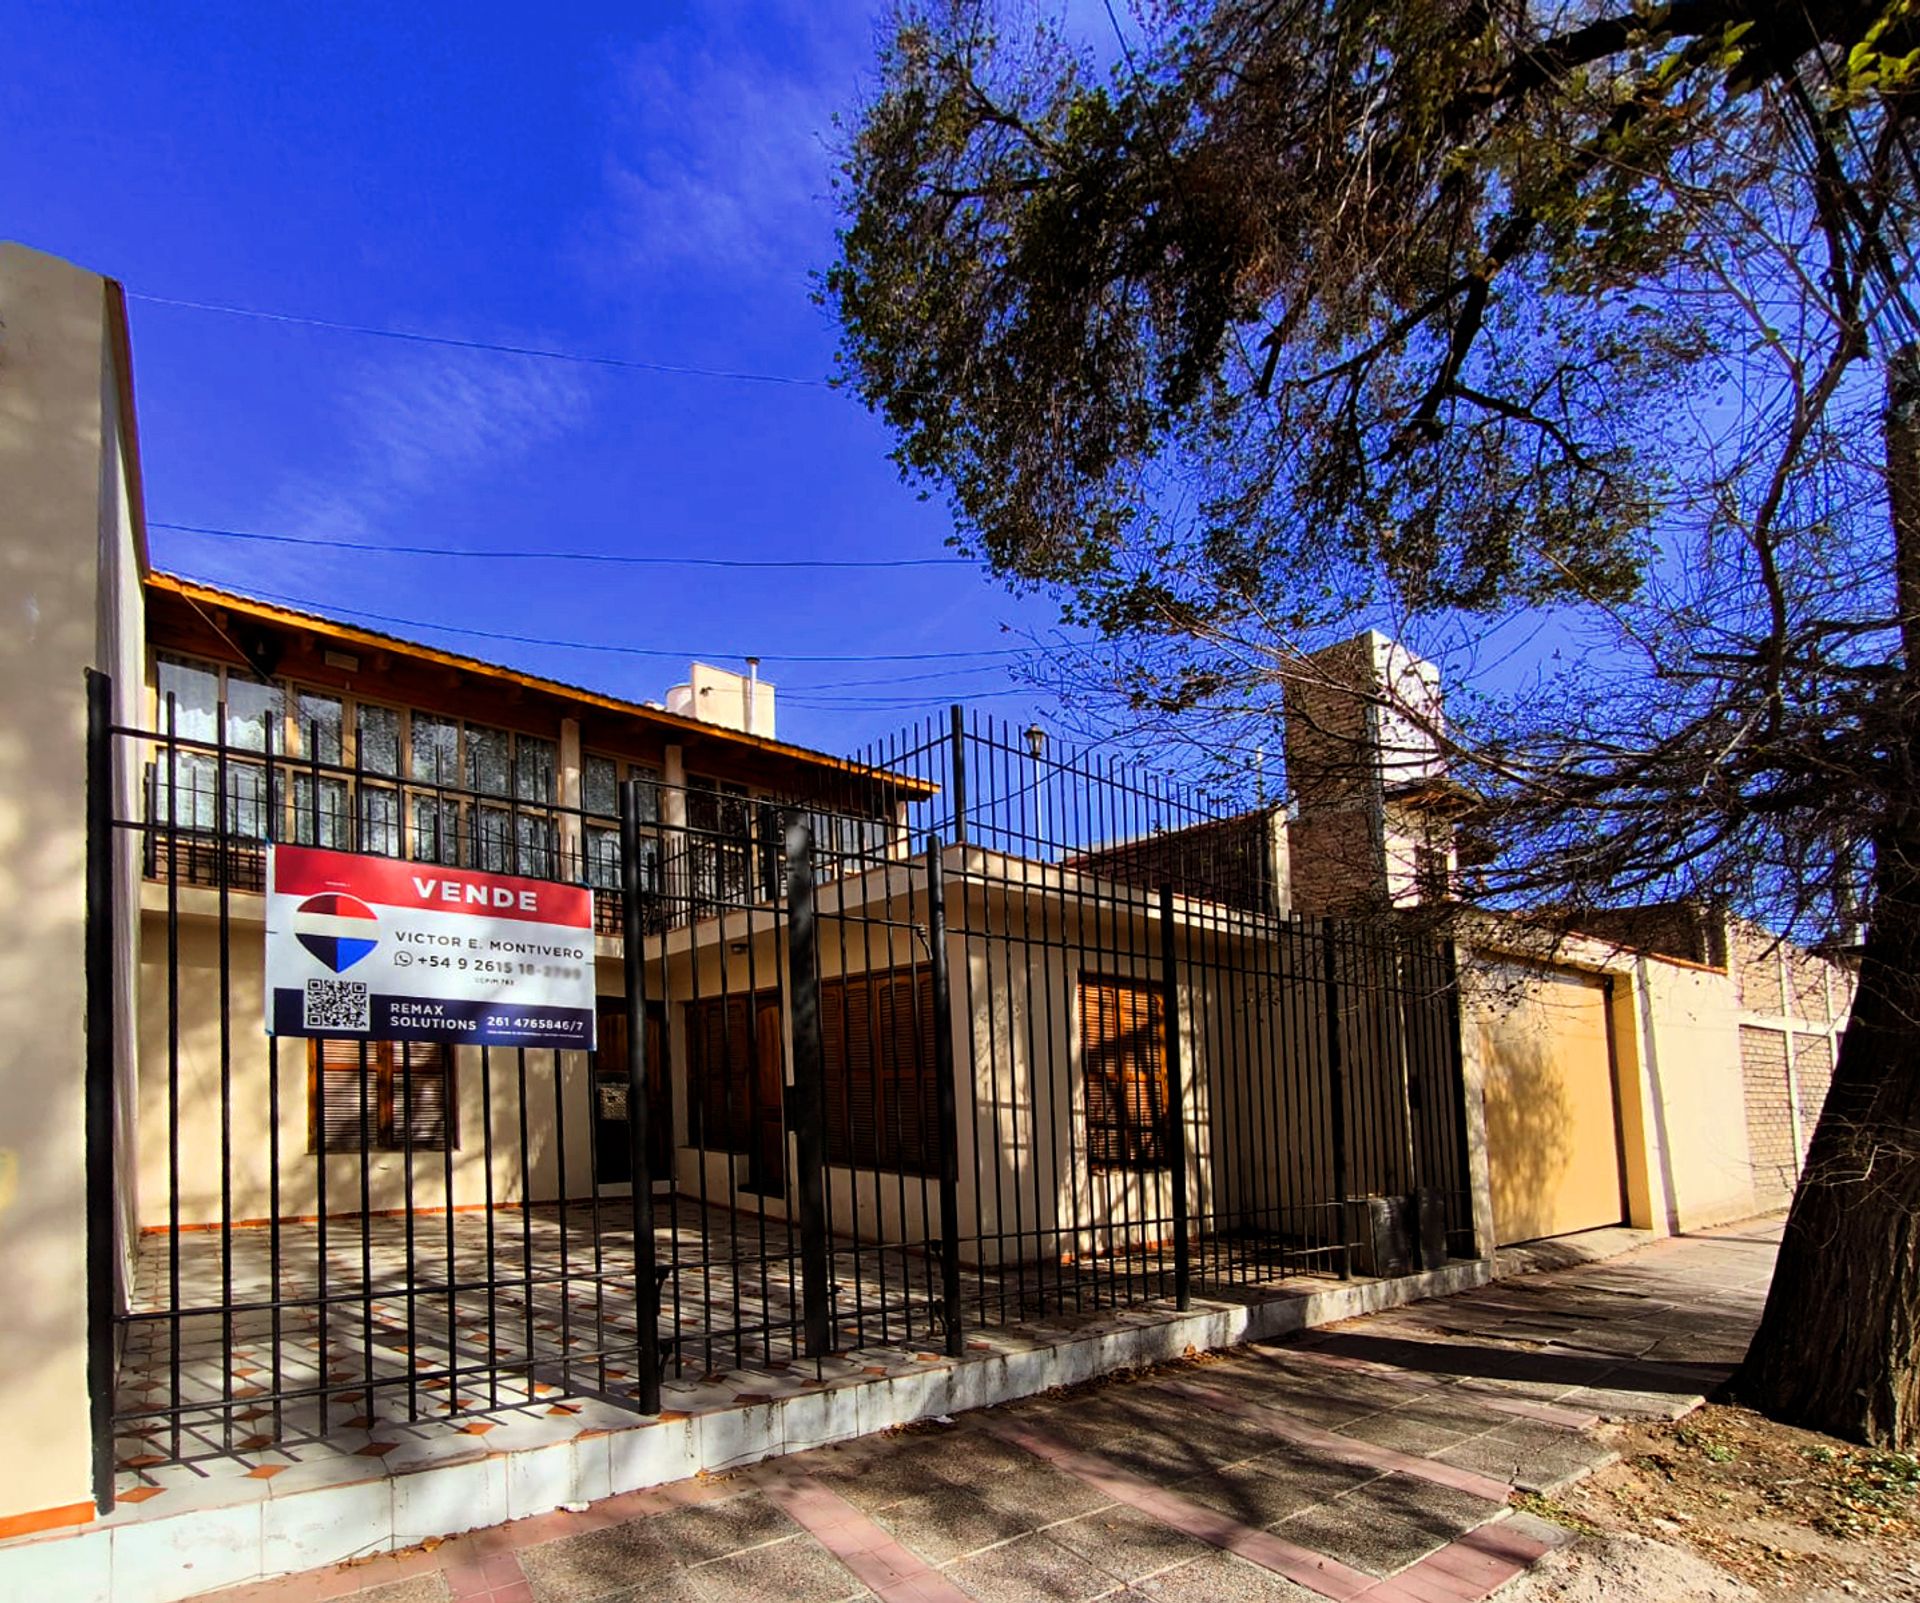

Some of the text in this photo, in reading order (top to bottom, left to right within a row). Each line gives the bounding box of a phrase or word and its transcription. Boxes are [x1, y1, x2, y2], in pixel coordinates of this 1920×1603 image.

[412, 877, 537, 911] VENDE
[395, 931, 584, 960] VICTOR E. MONTIVERO
[418, 955, 450, 968] +54
[458, 957, 468, 970] 9
[474, 959, 513, 974] 2615
[390, 1003, 443, 1016] REMAX
[390, 1016, 477, 1030] SOLUTIONS
[487, 1016, 509, 1027] 261
